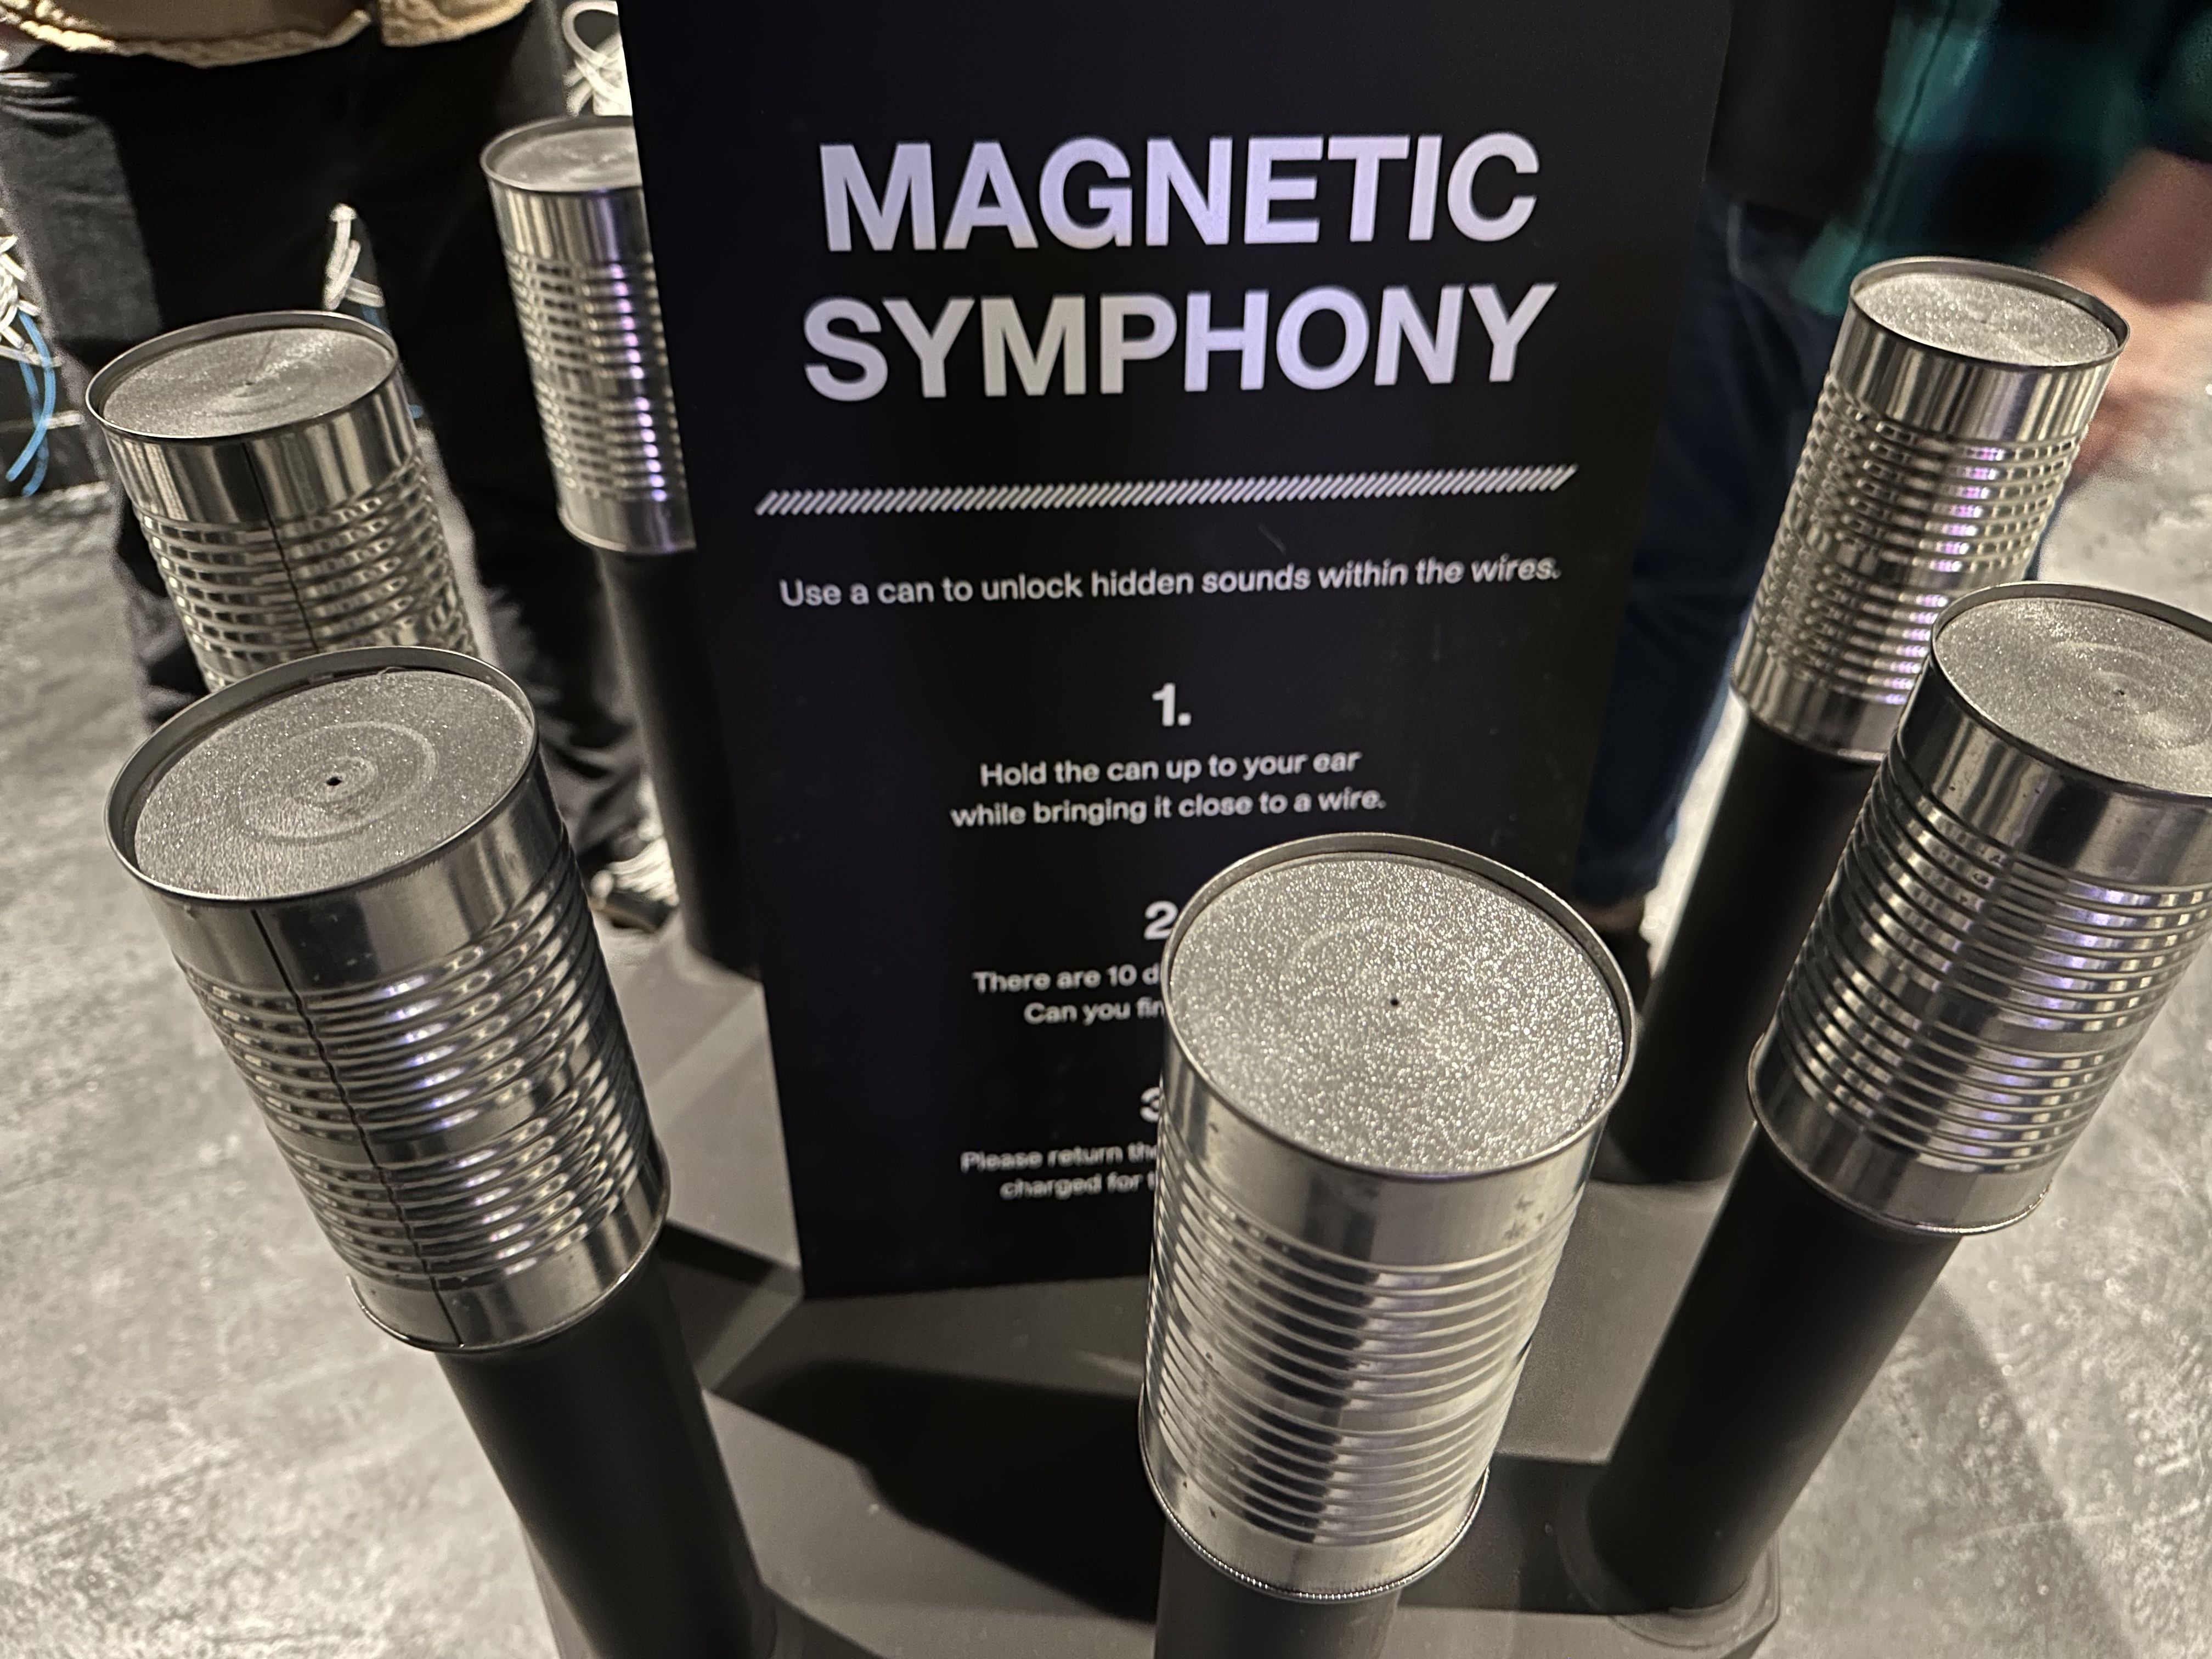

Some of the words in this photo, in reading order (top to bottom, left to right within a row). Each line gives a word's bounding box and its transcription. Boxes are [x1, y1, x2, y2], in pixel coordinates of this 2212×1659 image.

[820, 132, 1539, 251] MAGNETIC
[804, 283, 1557, 401] SYMPHONY
[780, 579, 842, 607] Use
[850, 583, 870, 605] a
[877, 582, 934, 604] can
[942, 577, 973, 602] to
[981, 572, 1083, 601] unlock
[1091, 569, 1194, 597] hidden
[1201, 564, 1311, 593] sounds
[1318, 559, 1408, 589] within
[1415, 557, 1464, 585] the
[1471, 554, 1560, 583] wires.
[1152, 683, 1192, 726] 1.
[980, 761, 1047, 787] Hold
[1054, 760, 1100, 784] the
[1107, 761, 1159, 782] can
[1166, 759, 1202, 783] up
[1208, 755, 1237, 777] to
[1243, 754, 1308, 781] your
[1313, 752, 1361, 773] ear
[950, 803, 1026, 827] while
[1033, 798, 1147, 826] bringing
[1154, 796, 1171, 819] it
[1178, 793, 1253, 817] close
[1259, 792, 1288, 814] to
[1293, 793, 1312, 812] a
[1318, 787, 1385, 811] wire.
[973, 971, 1051, 992] There
[1057, 970, 1101, 989] are
[1107, 964, 1137, 986] 10
[1024, 1002, 1077, 1024] Can
[1082, 1002, 1131, 1025] you
[960, 1150, 1043, 1173] Please
[1047, 1145, 1124, 1168] return
[1127, 1141, 1157, 1164] th
[1000, 1172, 1103, 1200] charged
[1107, 1171, 1143, 1193] for
